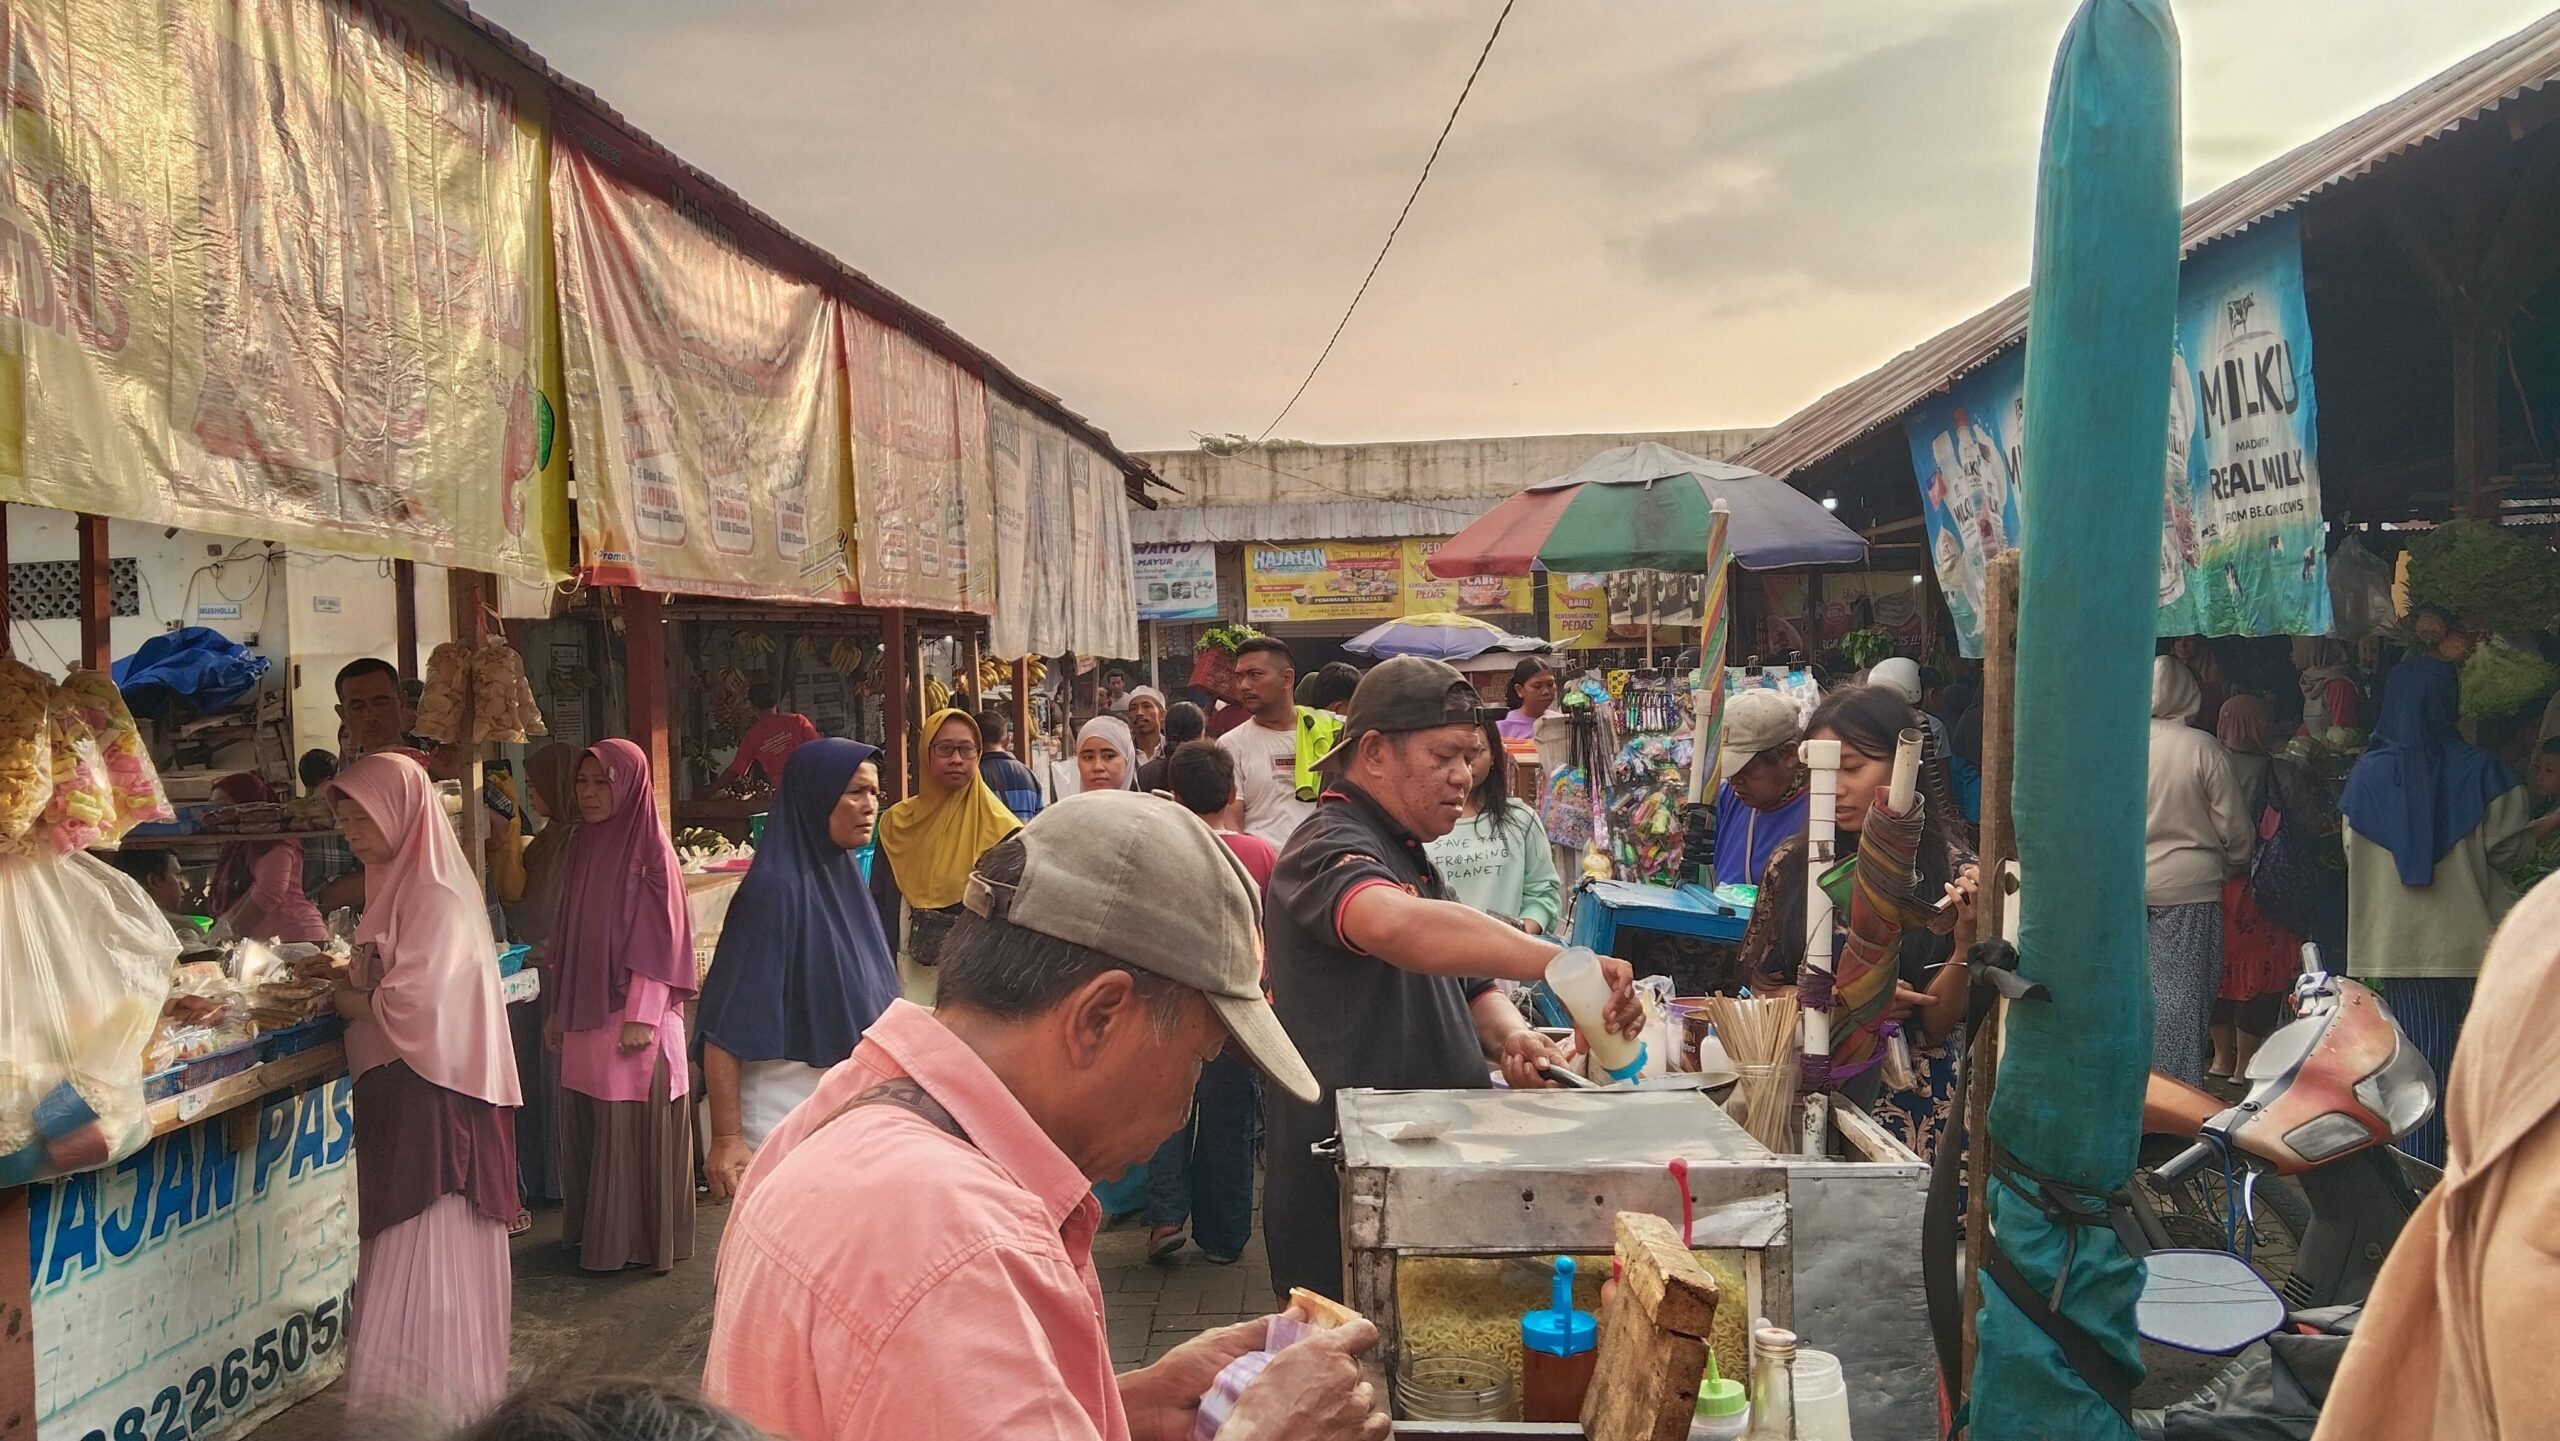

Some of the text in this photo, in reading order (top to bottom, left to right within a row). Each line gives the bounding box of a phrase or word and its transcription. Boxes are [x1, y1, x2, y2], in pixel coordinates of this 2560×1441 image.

[2199, 340, 2299, 439] MILKU
[2209, 459, 2265, 500] REAL
[640, 485, 679, 509] BONUS
[1420, 541, 1447, 555] PED
[1253, 548, 1328, 570] HAJATAN
[1466, 575, 1496, 586] CABE
[1416, 589, 1446, 600] PEDAS
[1568, 598, 1594, 609] BARU!
[200, 607, 238, 615] MUSHOLLA
[1561, 619, 1595, 631] PEDAS
[1435, 838, 1470, 849] SAVE
[1447, 864, 1503, 880] PLANET
